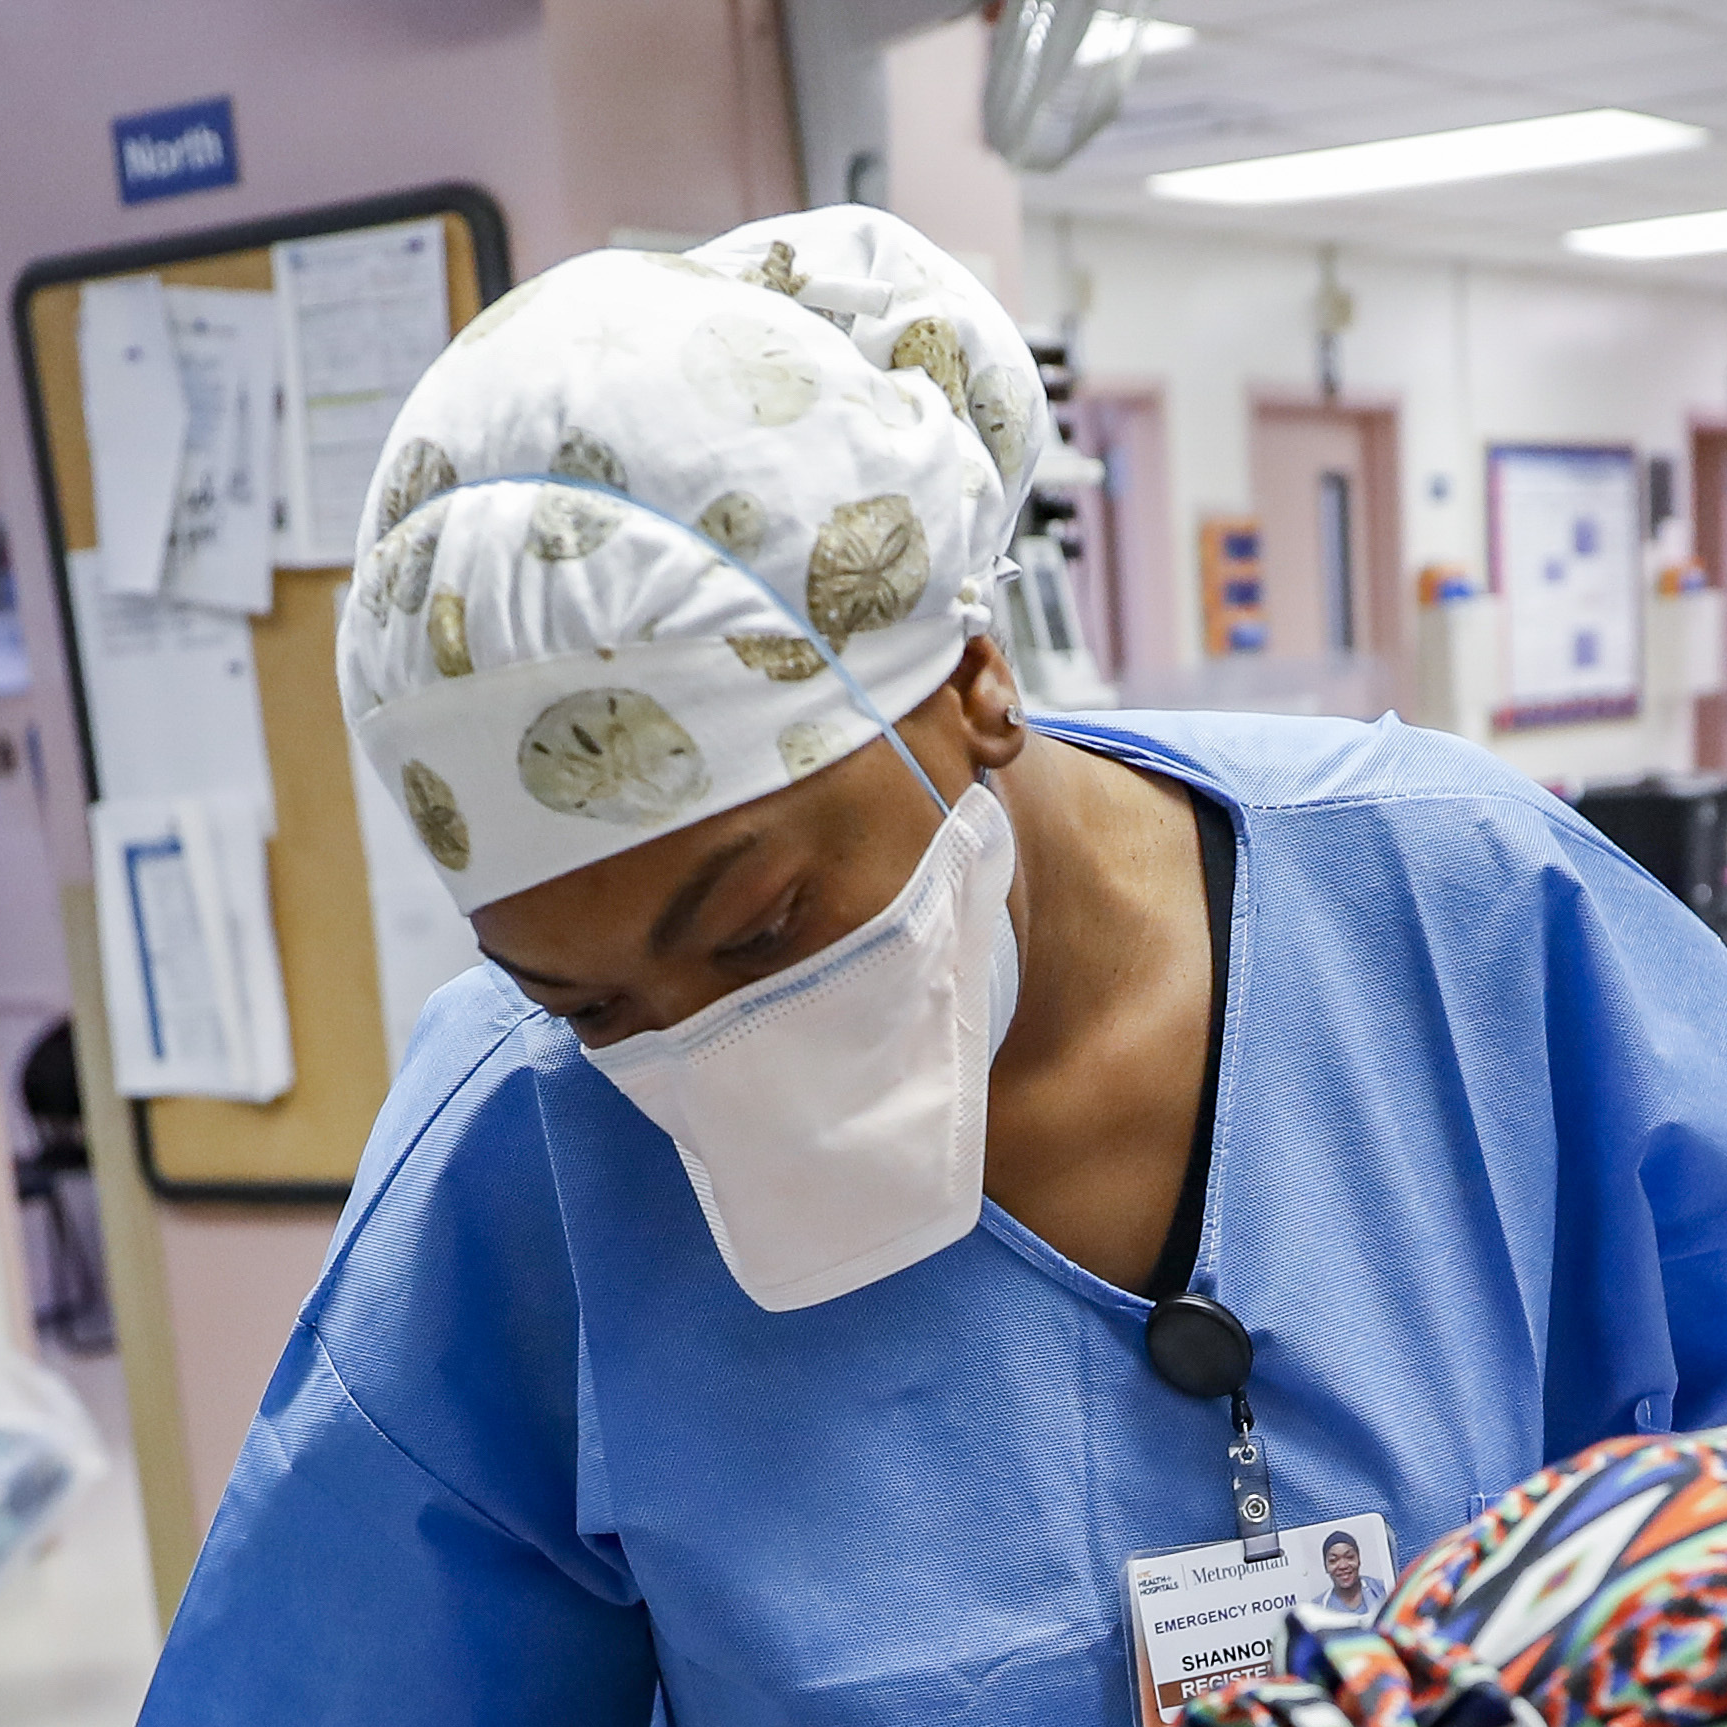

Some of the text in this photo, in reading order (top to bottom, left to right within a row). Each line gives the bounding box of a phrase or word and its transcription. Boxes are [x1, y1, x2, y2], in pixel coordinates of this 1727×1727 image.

[122, 124, 225, 183] North
[1139, 1581, 1179, 1597] HOSPITALS
[1154, 1594, 1297, 1635] EMERGENCY ROOM
[1180, 1664, 1271, 1699] REGISTE
